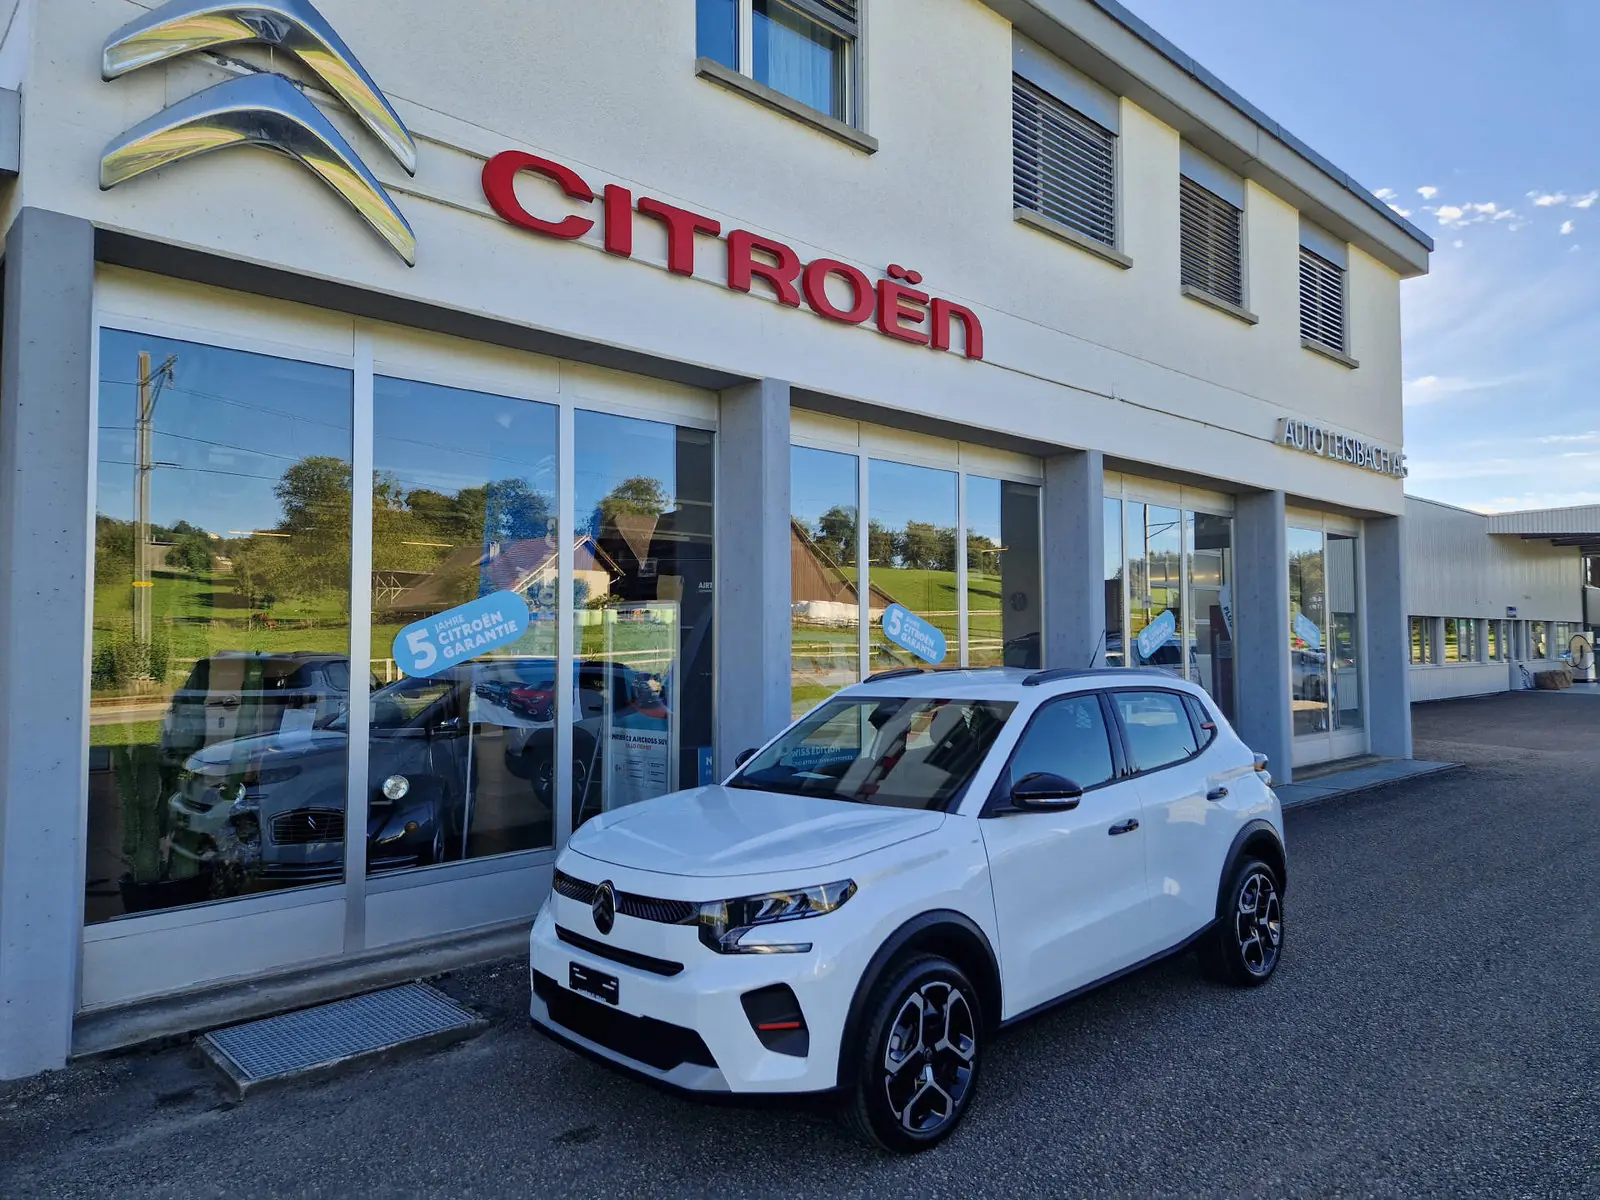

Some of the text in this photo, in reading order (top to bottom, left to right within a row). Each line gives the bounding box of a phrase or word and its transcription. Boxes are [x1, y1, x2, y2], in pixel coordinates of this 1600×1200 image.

[1281, 418, 1409, 478] AUTO LEISIBACH AG
[435, 615, 466, 633] JAHRE
[438, 610, 503, 645] CITROËN
[443, 620, 518, 659] GARANTIE
[887, 608, 903, 636] 5
[405, 628, 437, 670] 5
[788, 746, 841, 757] WISS EDITION
